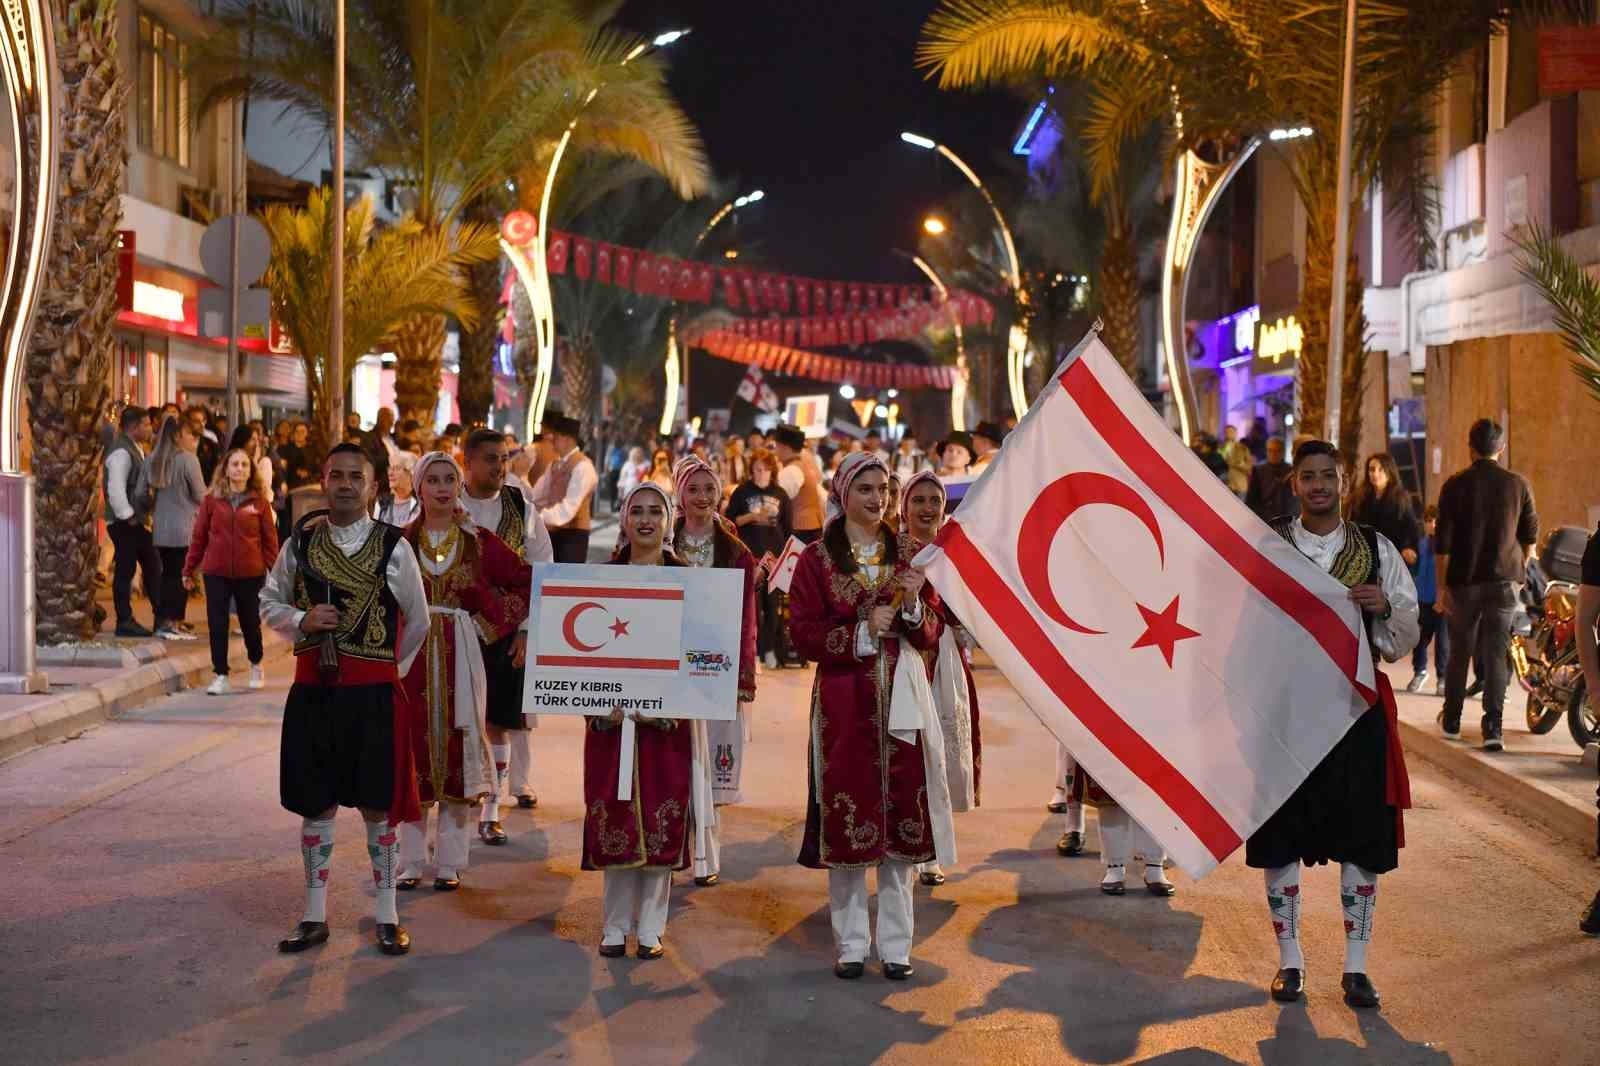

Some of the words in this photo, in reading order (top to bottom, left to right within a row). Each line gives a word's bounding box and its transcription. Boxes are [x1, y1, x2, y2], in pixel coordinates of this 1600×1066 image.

[535, 680, 577, 690] KUZEY
[580, 681, 623, 692] KIBRIS
[534, 693, 568, 706] TÜRK
